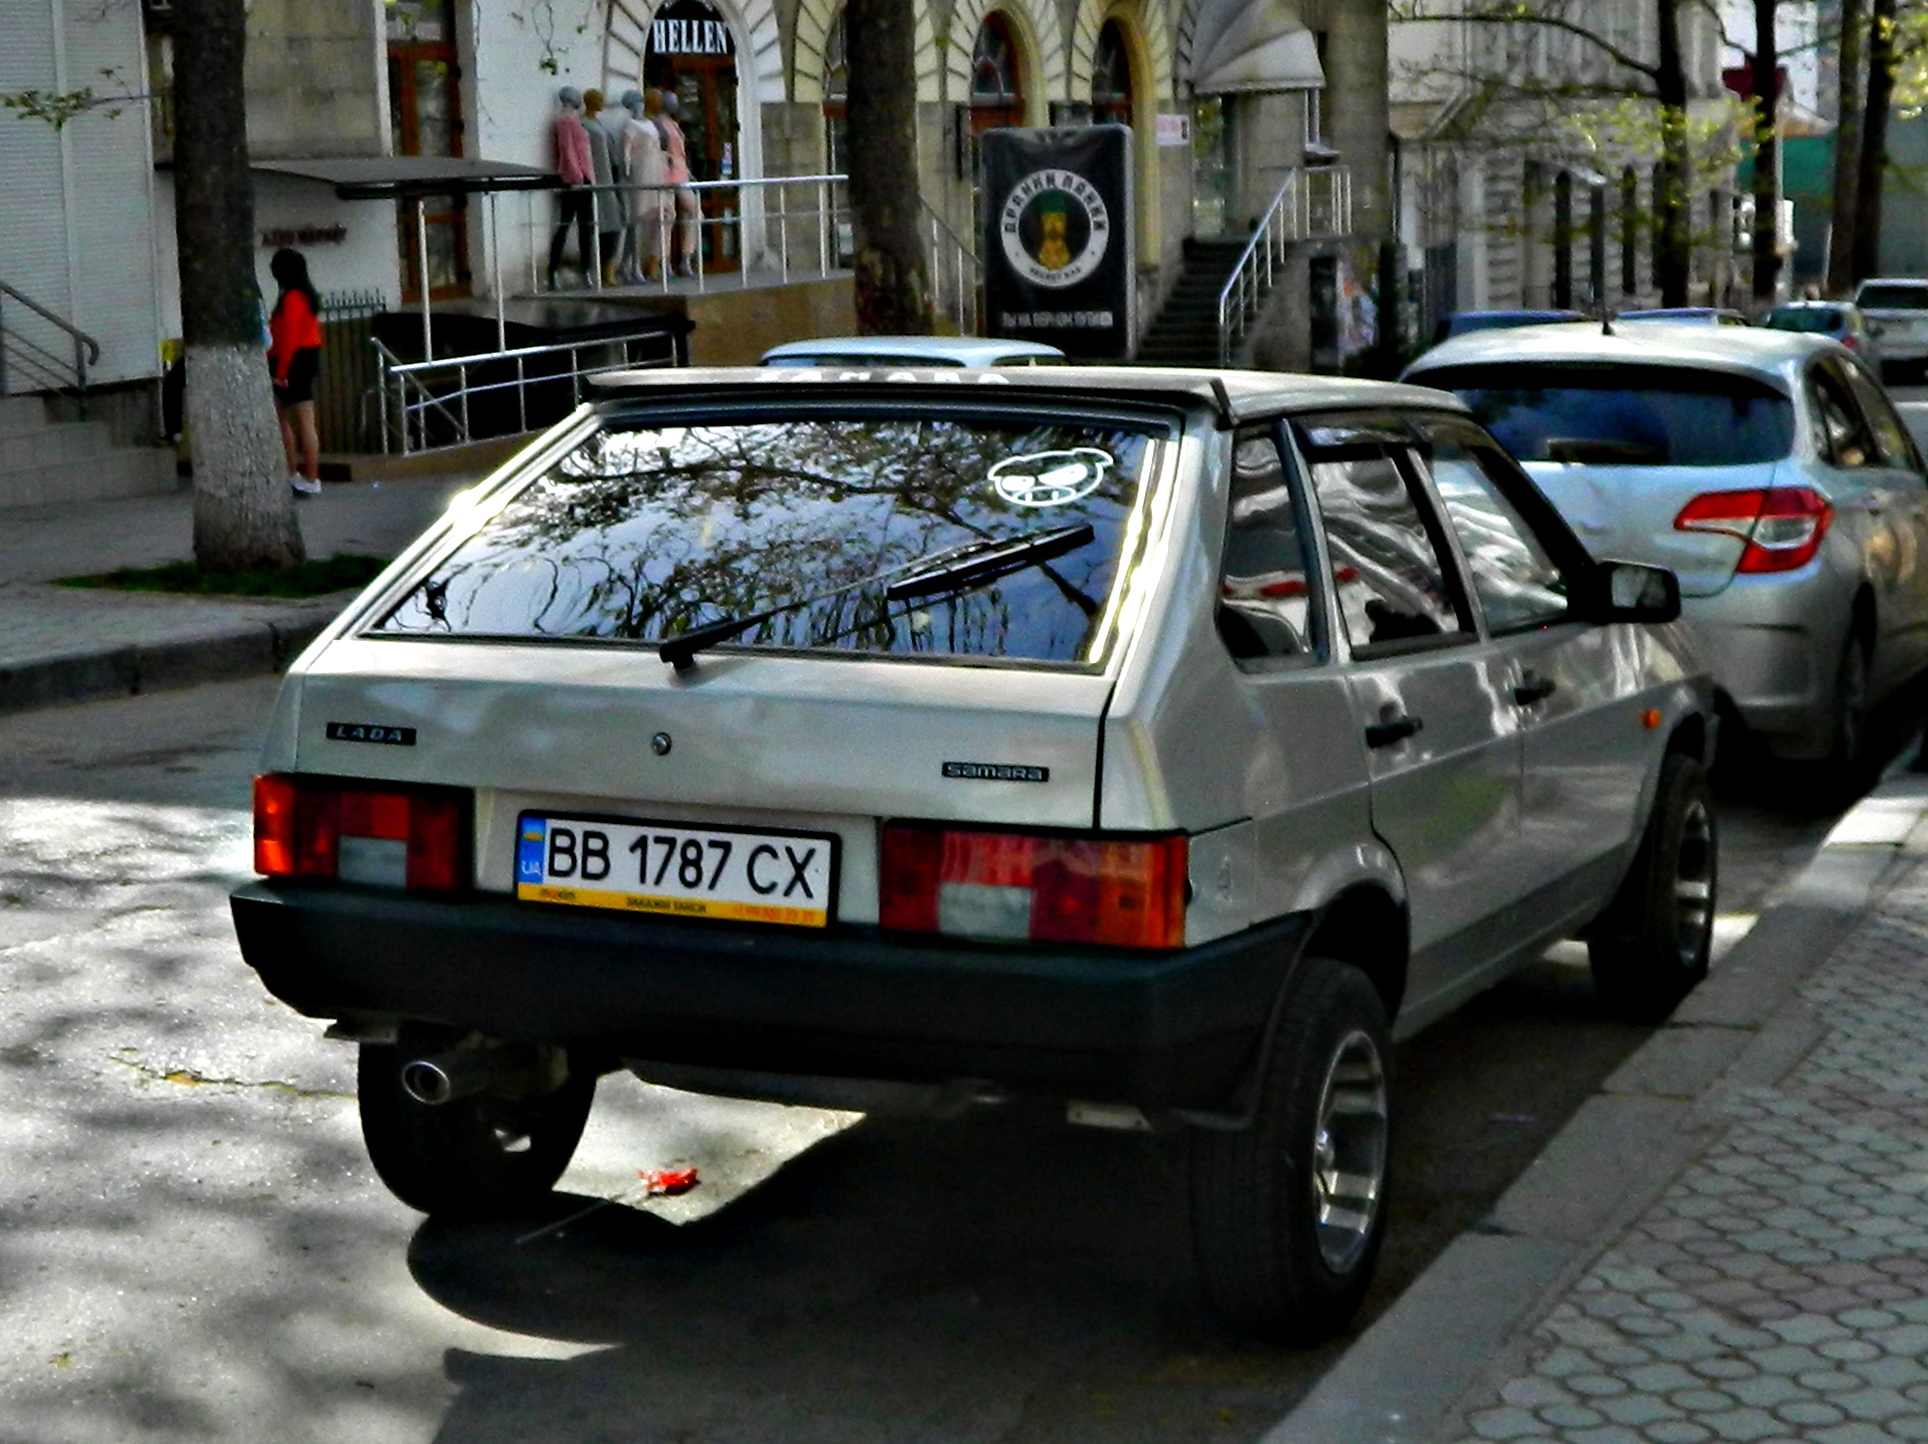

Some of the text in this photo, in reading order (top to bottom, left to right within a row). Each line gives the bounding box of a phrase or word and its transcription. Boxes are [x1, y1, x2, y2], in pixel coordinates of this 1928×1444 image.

[652, 19, 728, 54] HELLEN
[335, 725, 402, 742] LADA
[548, 828, 816, 899] BB 1787 CX
